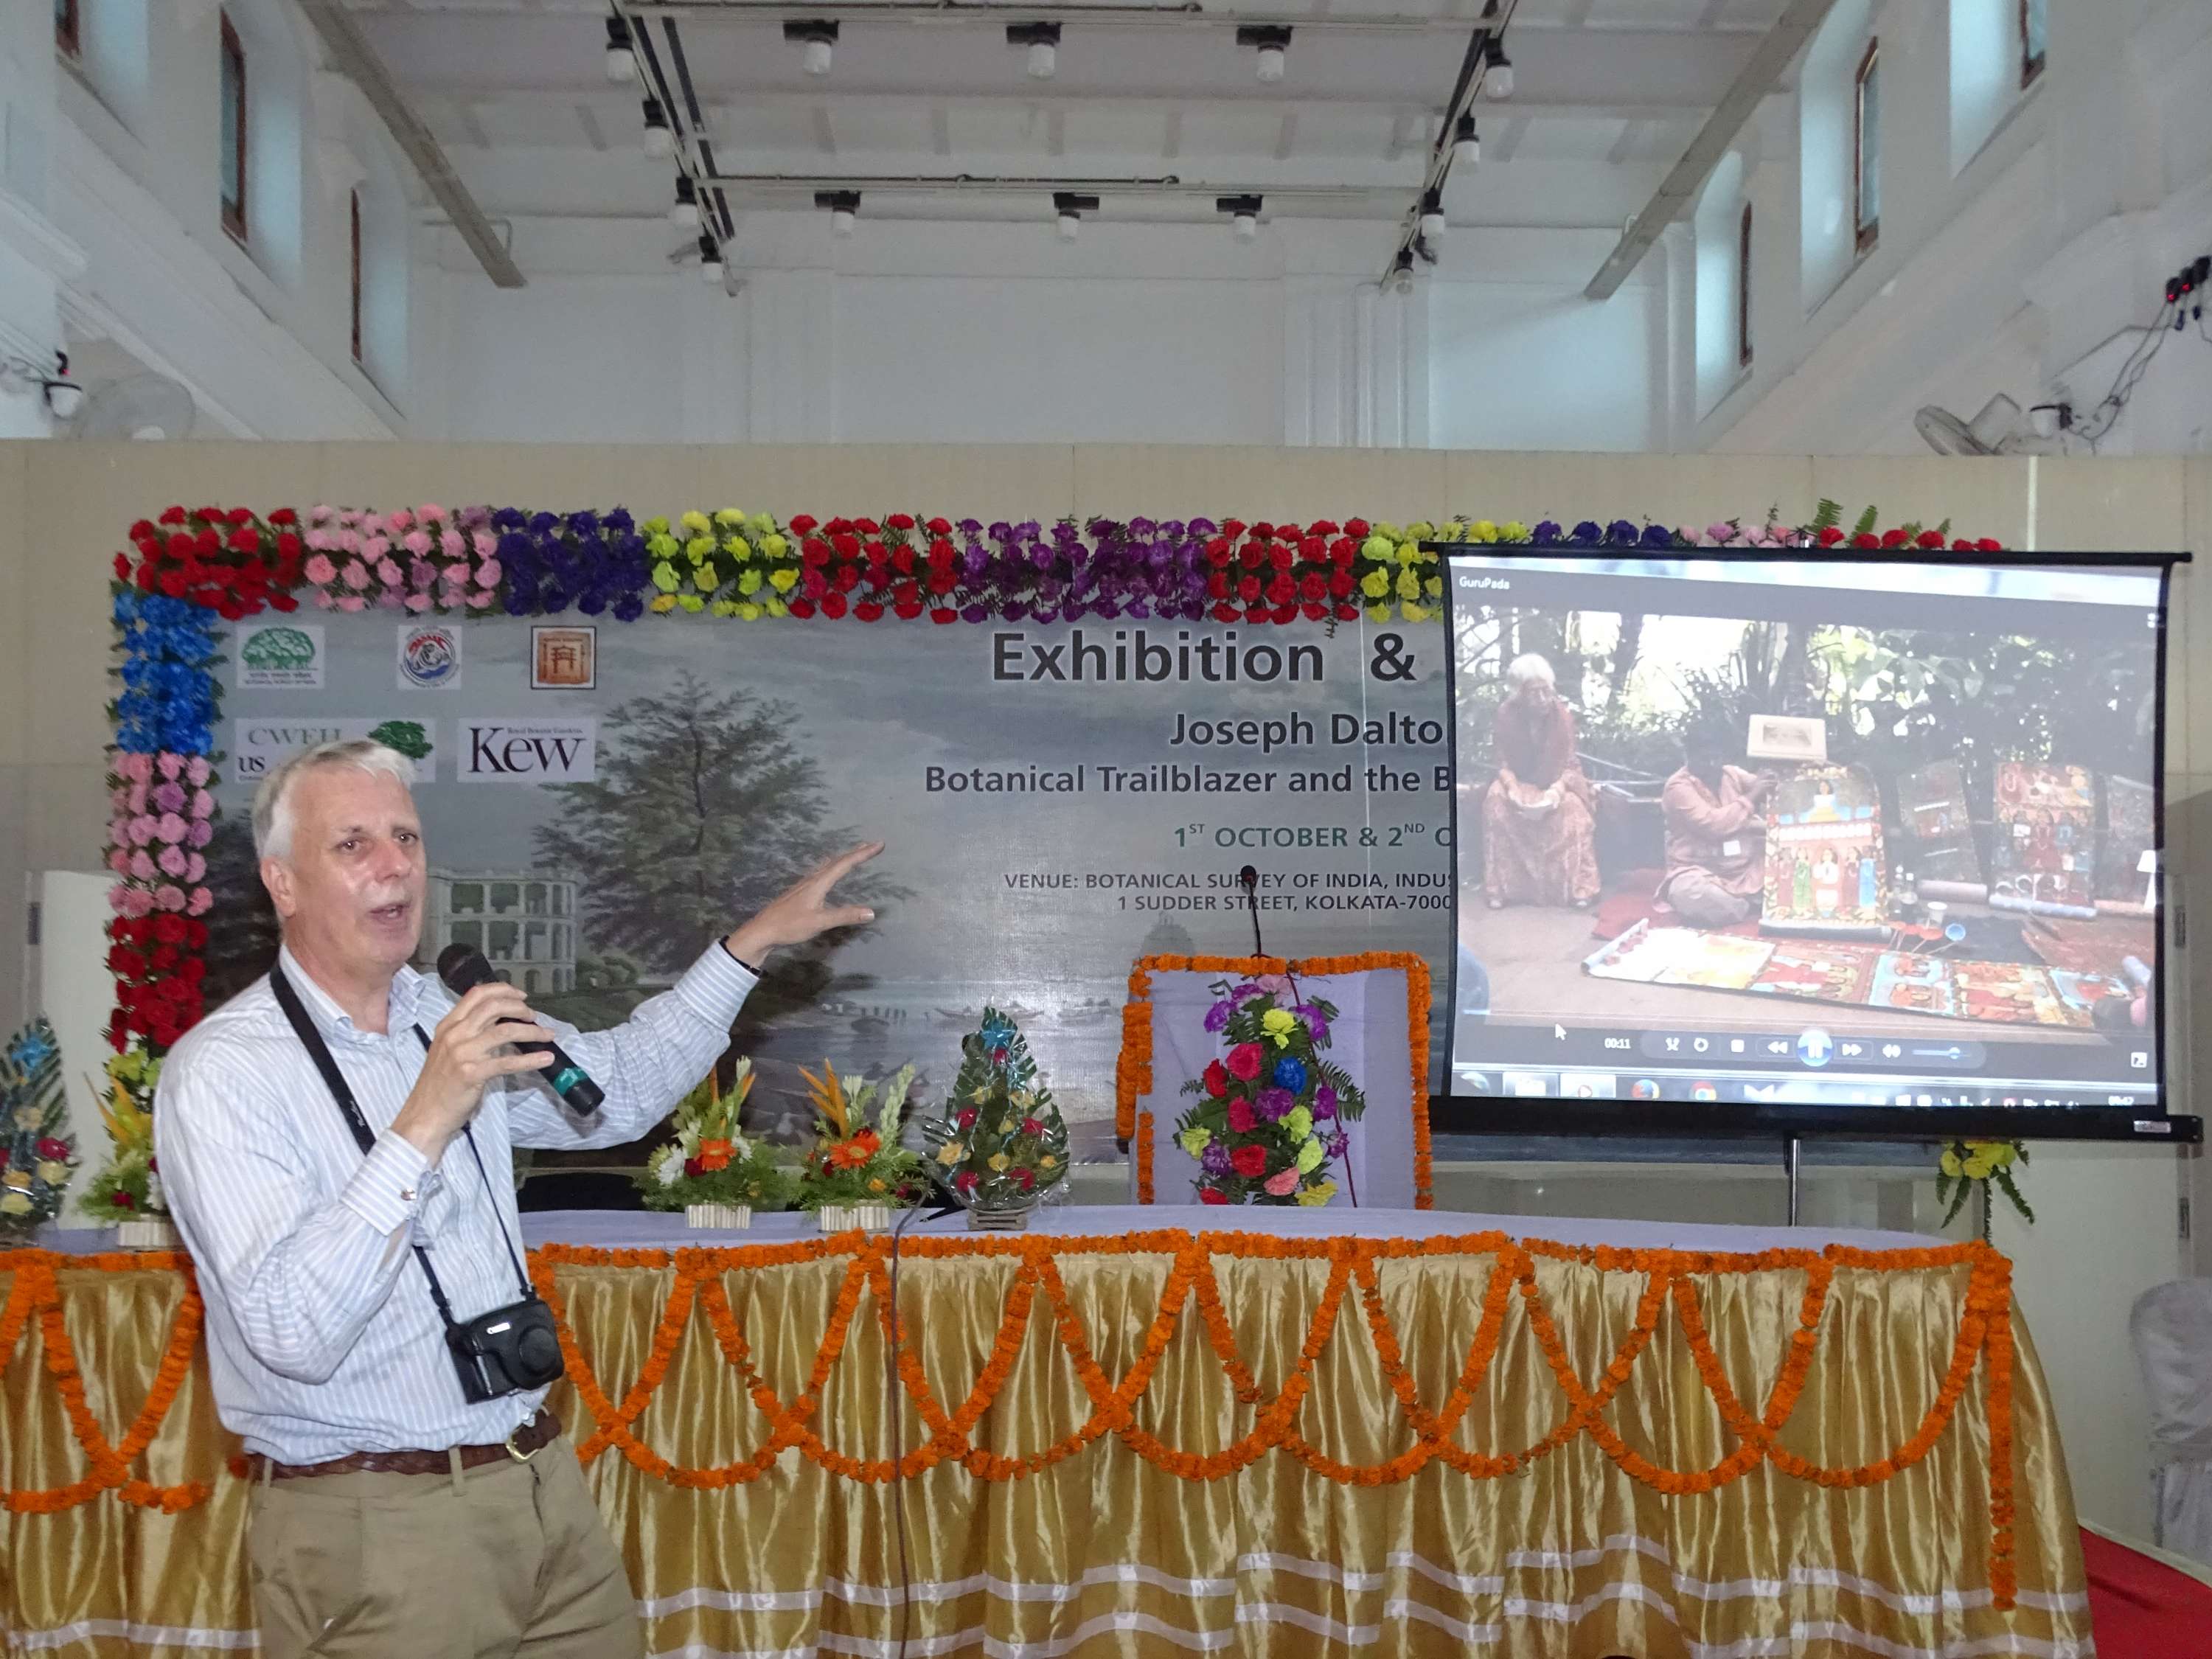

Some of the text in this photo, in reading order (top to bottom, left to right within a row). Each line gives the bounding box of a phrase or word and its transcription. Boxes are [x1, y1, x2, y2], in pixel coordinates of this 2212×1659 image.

[1459, 576, 1510, 590] GuruPada
[993, 632, 1416, 681] Exhibition &
[1170, 712, 1443, 754] Joseph Dalto
[467, 727, 587, 773] Kew
[926, 765, 1084, 792] Botanical
[1096, 765, 1277, 793] Trailblazer
[1288, 765, 1352, 793] and
[1363, 765, 1421, 792] the
[1175, 823, 1205, 847] 1ST
[1214, 827, 1348, 847] OCTOBER
[1358, 827, 1378, 847] &
[1388, 823, 1425, 847] 2ND
[1005, 874, 1078, 888] VENUE:
[1086, 874, 1200, 888] BOTANICAL
[1293, 873, 1319, 888] OF
[1326, 873, 1388, 889] INDIA,
[1396, 873, 1451, 888] INDU
[1119, 896, 1125, 910] 1
[1135, 896, 1217, 911] SUDDER
[1224, 895, 1298, 911] STREET,
